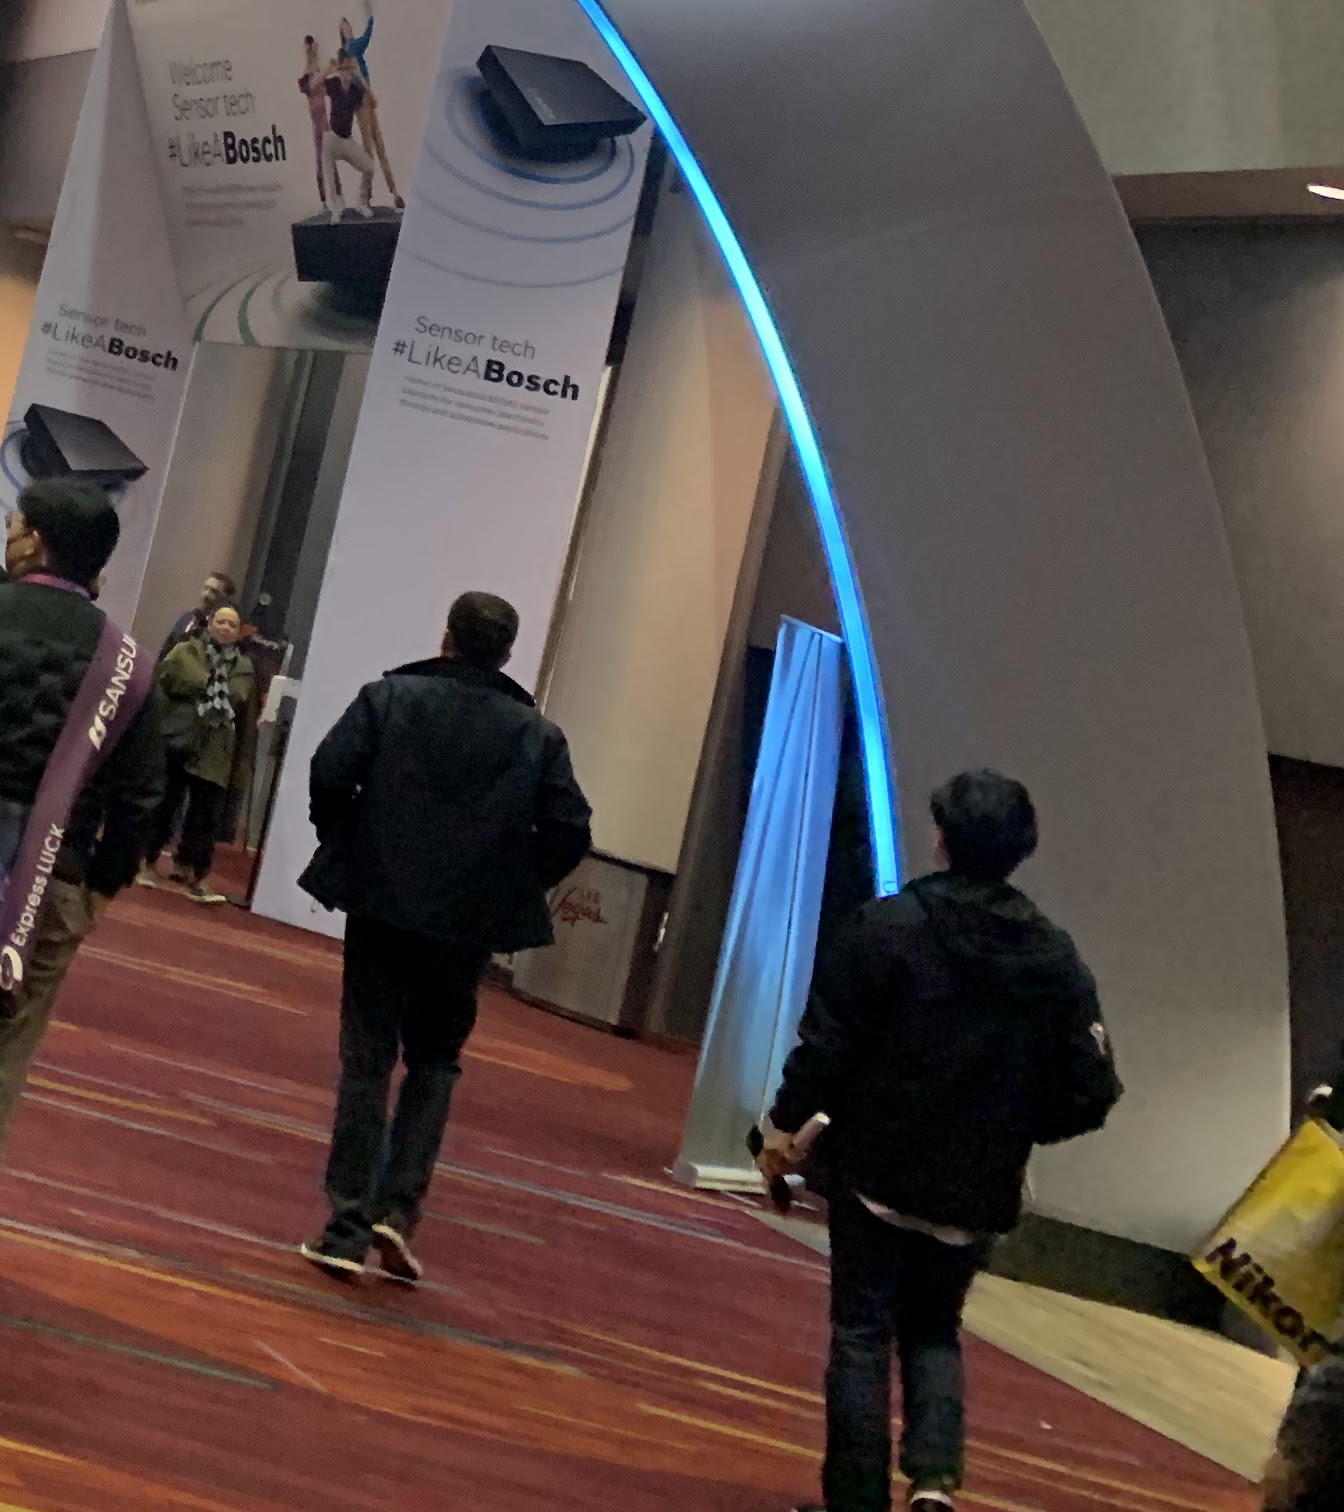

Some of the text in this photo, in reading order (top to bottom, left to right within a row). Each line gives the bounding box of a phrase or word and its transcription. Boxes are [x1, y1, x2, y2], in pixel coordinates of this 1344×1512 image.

[168, 57, 232, 87] Welcome
[172, 90, 256, 121] Sensor tech
[167, 124, 286, 167] #LikeABosch
[58, 302, 148, 338] Sensor tech
[414, 315, 536, 360] Sensor tech
[40, 320, 179, 372] #LikeABosch
[392, 338, 581, 401] #LikeABosch
[12, 823, 66, 947] Express LUCK
